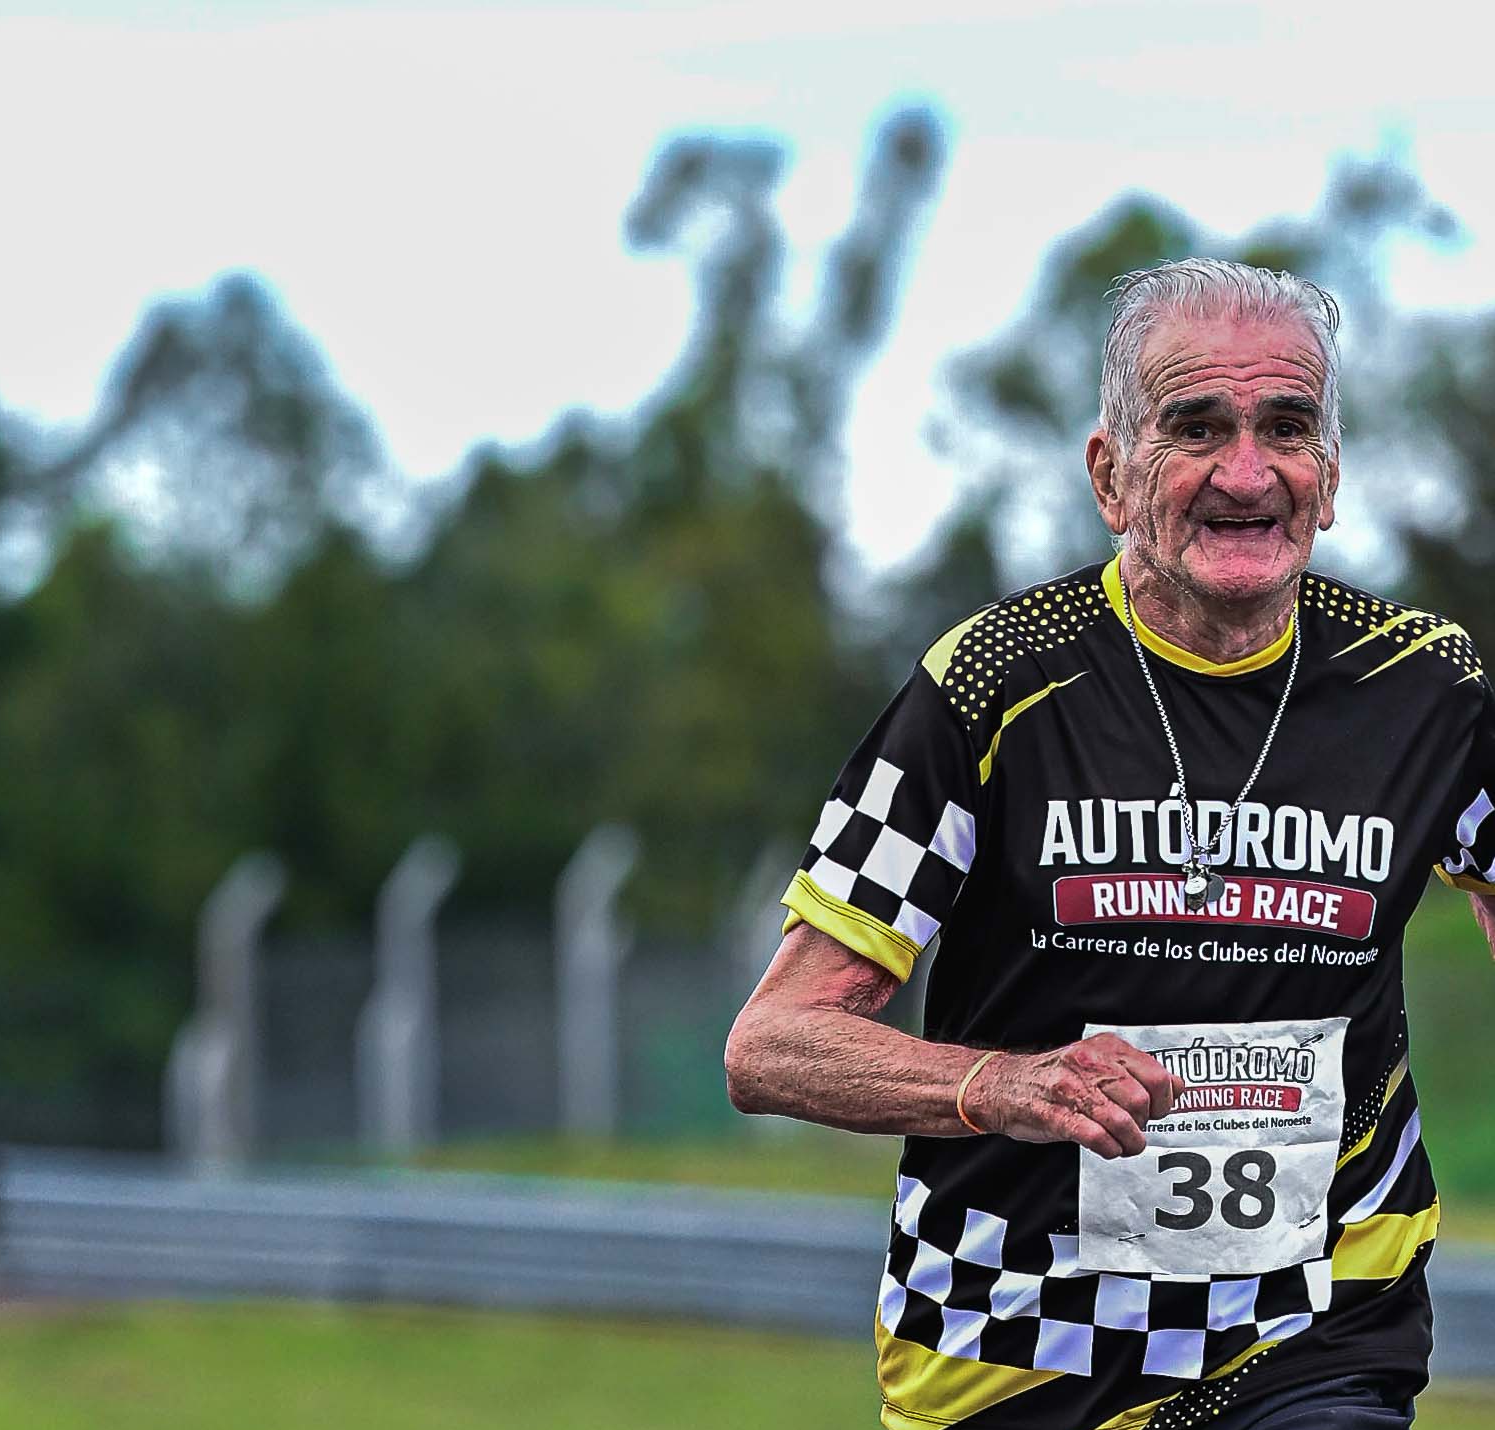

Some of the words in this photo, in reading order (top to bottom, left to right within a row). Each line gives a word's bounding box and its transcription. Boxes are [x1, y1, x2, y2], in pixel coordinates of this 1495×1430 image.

[1038, 783, 1395, 883] AUTÓDROMO
[1092, 881, 1241, 918] RUNNG
[1252, 885, 1342, 930] RACE
[1052, 932, 1127, 955] Carrera
[1134, 936, 1160, 958] de
[1165, 938, 1193, 960] los
[1198, 941, 1268, 963] Clubes
[1274, 942, 1306, 963] del
[1311, 944, 1378, 966] Noroeste
[1150, 1037, 1316, 1084] TÓDROMO
[1240, 1088, 1285, 1109] RACE
[1178, 1119, 1192, 1131] de
[1195, 1118, 1211, 1131] los
[1213, 1117, 1253, 1131] Clubes
[1254, 1116, 1269, 1129] del
[1271, 1115, 1312, 1128] Noroeste
[1154, 1150, 1278, 1231] 38
